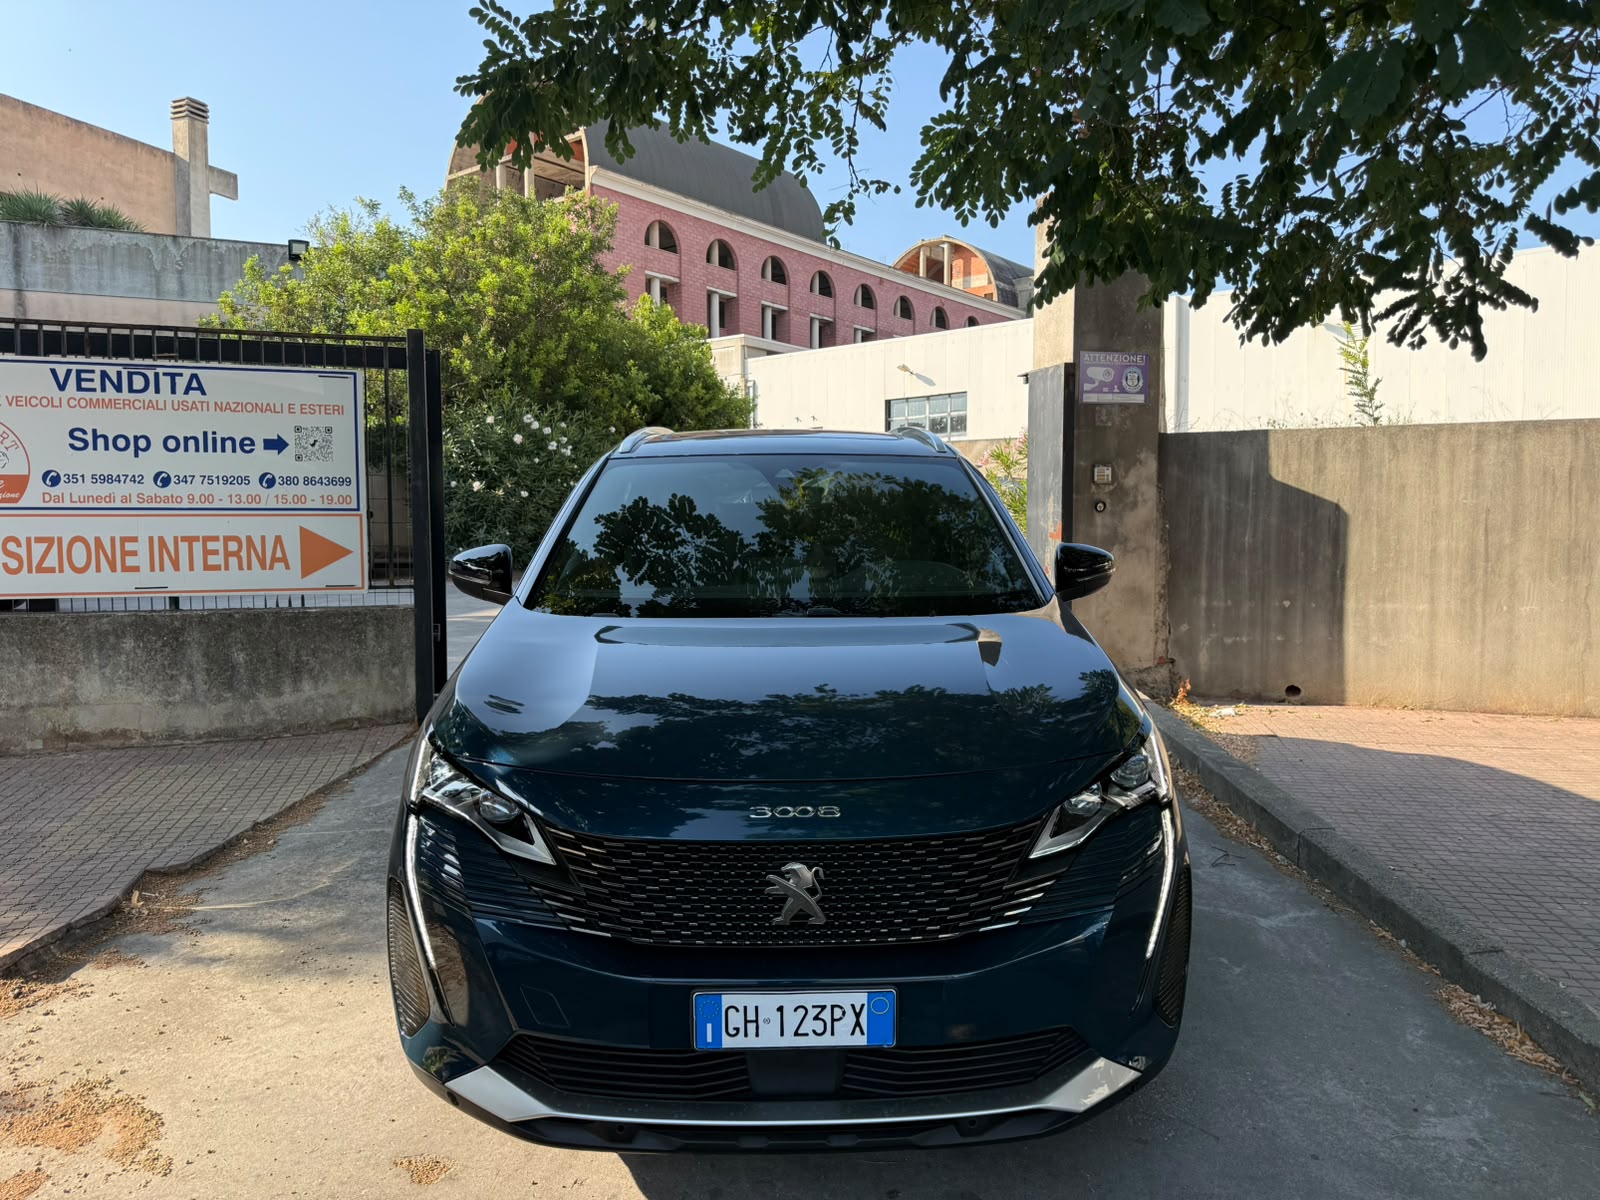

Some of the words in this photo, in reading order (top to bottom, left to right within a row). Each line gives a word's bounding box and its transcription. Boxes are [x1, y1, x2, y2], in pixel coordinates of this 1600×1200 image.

[49, 368, 207, 396] VENDITA
[6, 395, 63, 409] VEICOLI
[67, 397, 167, 411] COMMERCIALI
[171, 400, 210, 412] USATI
[214, 401, 284, 415] NAZIONALI
[288, 403, 296, 415] E
[300, 403, 345, 416] ESTERI
[68, 427, 152, 458] Shop
[162, 430, 256, 454] online
[63, 473, 86, 485] 351
[90, 473, 145, 485] 5984742
[173, 474, 196, 486] 347
[200, 474, 251, 486] 7519205
[278, 475, 300, 487] 380
[303, 475, 352, 487] 8643699
[42, 492, 65, 504] Dal
[69, 491, 117, 504] Lunedì
[120, 492, 132, 505] al
[136, 492, 184, 505] Sabato
[187, 493, 215, 505] 9.00
[227, 493, 262, 505] 13.00
[273, 494, 308, 505] 15.00
[319, 494, 353, 506] 19.00
[1, 535, 141, 575] SIZIONE
[147, 535, 291, 573] INTERNA
[749, 806, 842, 819] 3008
[724, 1004, 760, 1038] GH
[776, 1003, 866, 1038] 123PX
